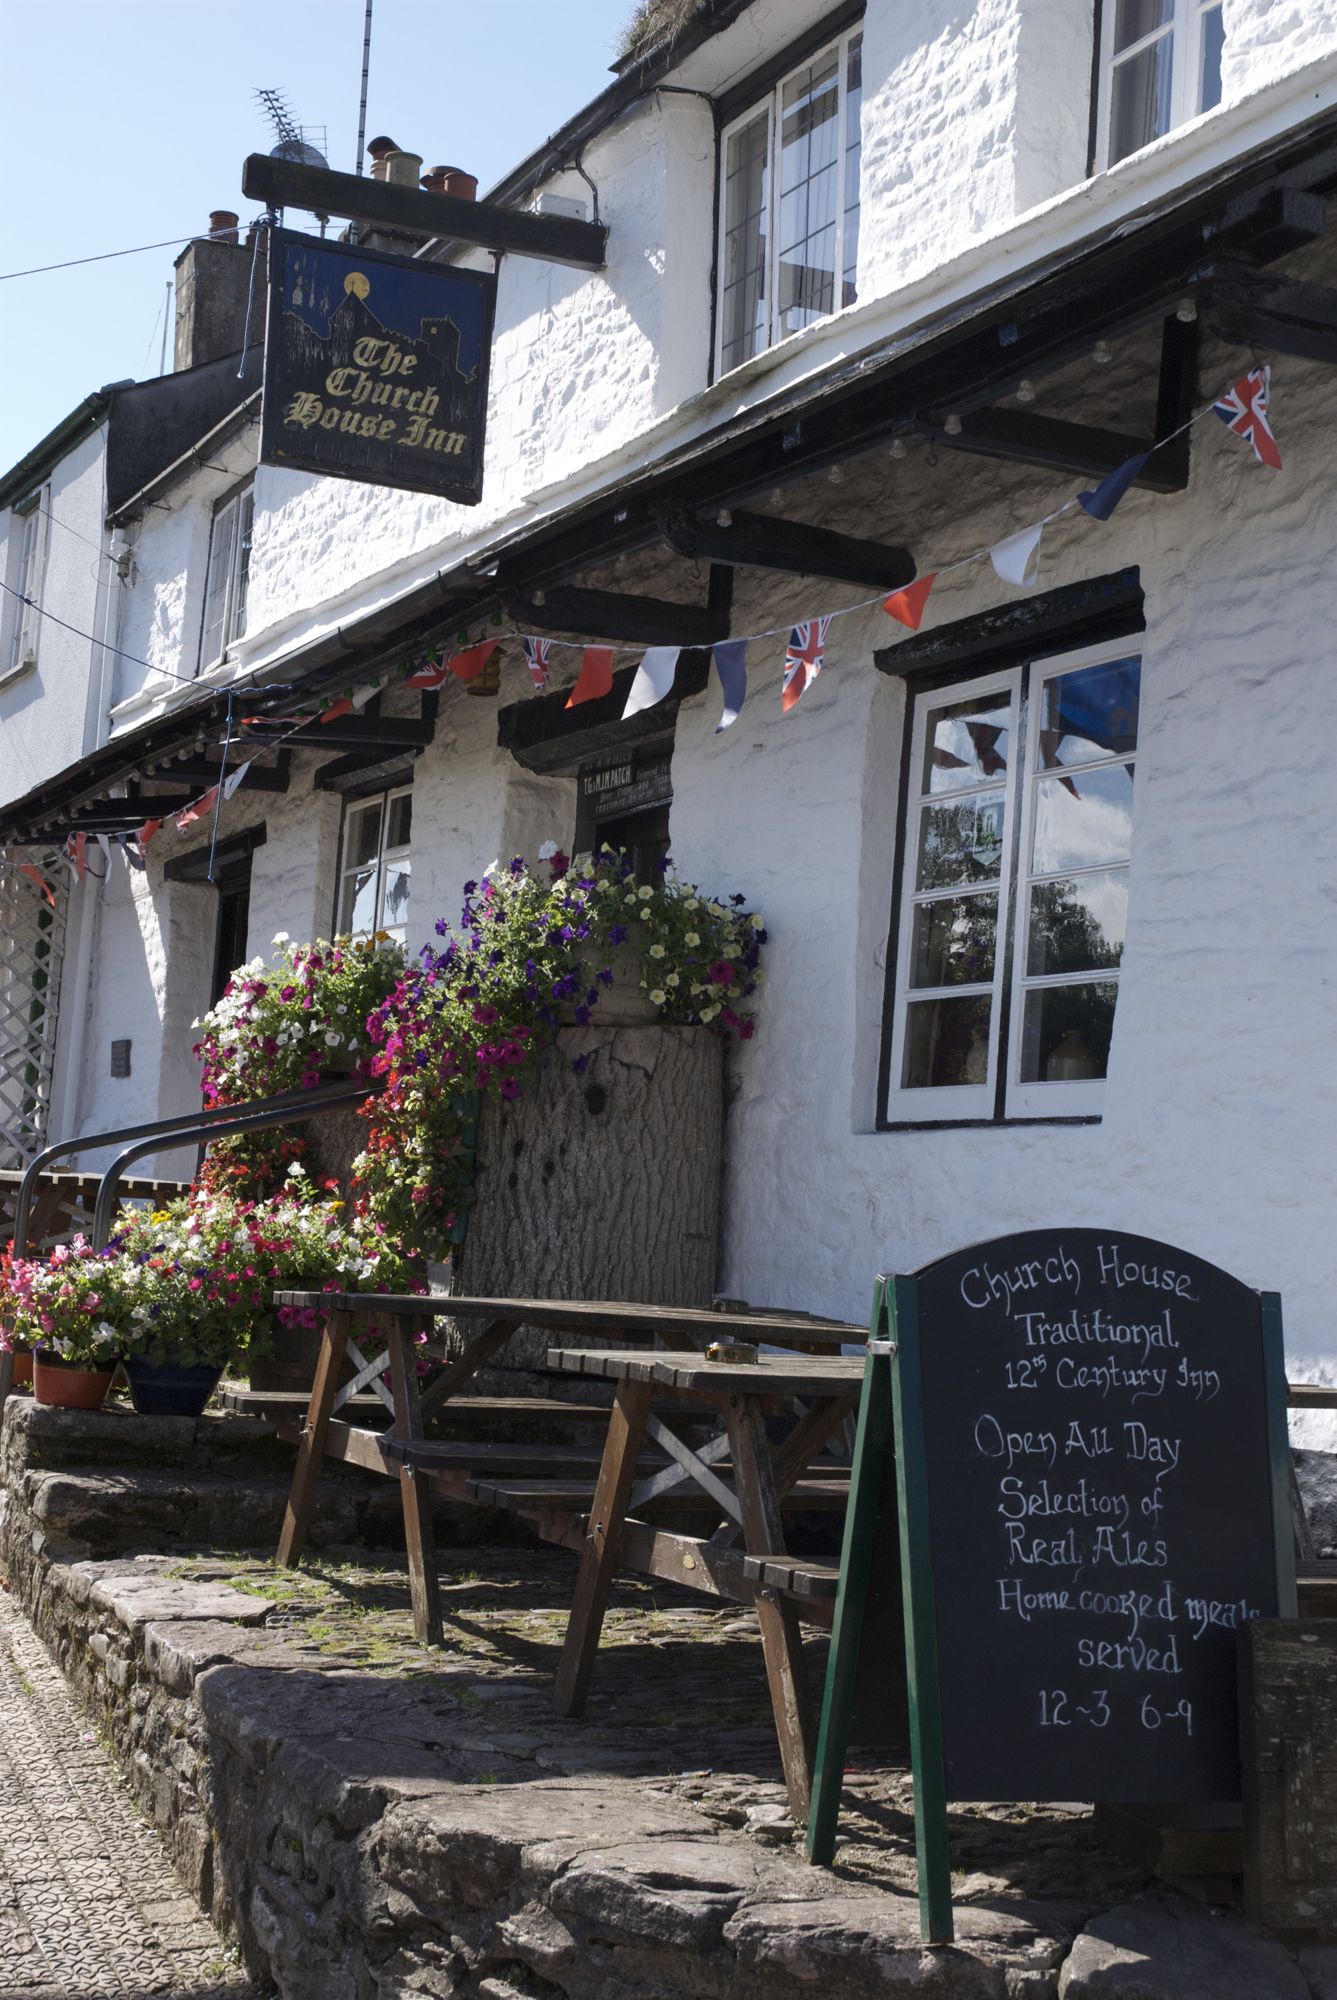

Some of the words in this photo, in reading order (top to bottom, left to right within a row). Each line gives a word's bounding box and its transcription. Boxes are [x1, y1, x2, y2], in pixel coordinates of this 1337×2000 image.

[353, 336, 418, 376] The
[325, 367, 440, 416] Church
[284, 391, 396, 441] House
[397, 415, 467, 455] Inn
[961, 1245, 1081, 1316] Church
[1097, 1245, 1199, 1301] House
[1014, 1309, 1180, 1364] Traditional
[1056, 1356, 1167, 1404] Century
[1176, 1357, 1220, 1400] Inn
[974, 1414, 1057, 1469] Open
[1065, 1422, 1114, 1458] All
[1124, 1422, 1181, 1482] Day
[997, 1476, 1129, 1530] Selection
[1141, 1487, 1165, 1528] of
[1005, 1522, 1082, 1566] Real
[1092, 1526, 1168, 1567] Ales
[996, 1579, 1076, 1622] Home
[1078, 1634, 1183, 1674] served
